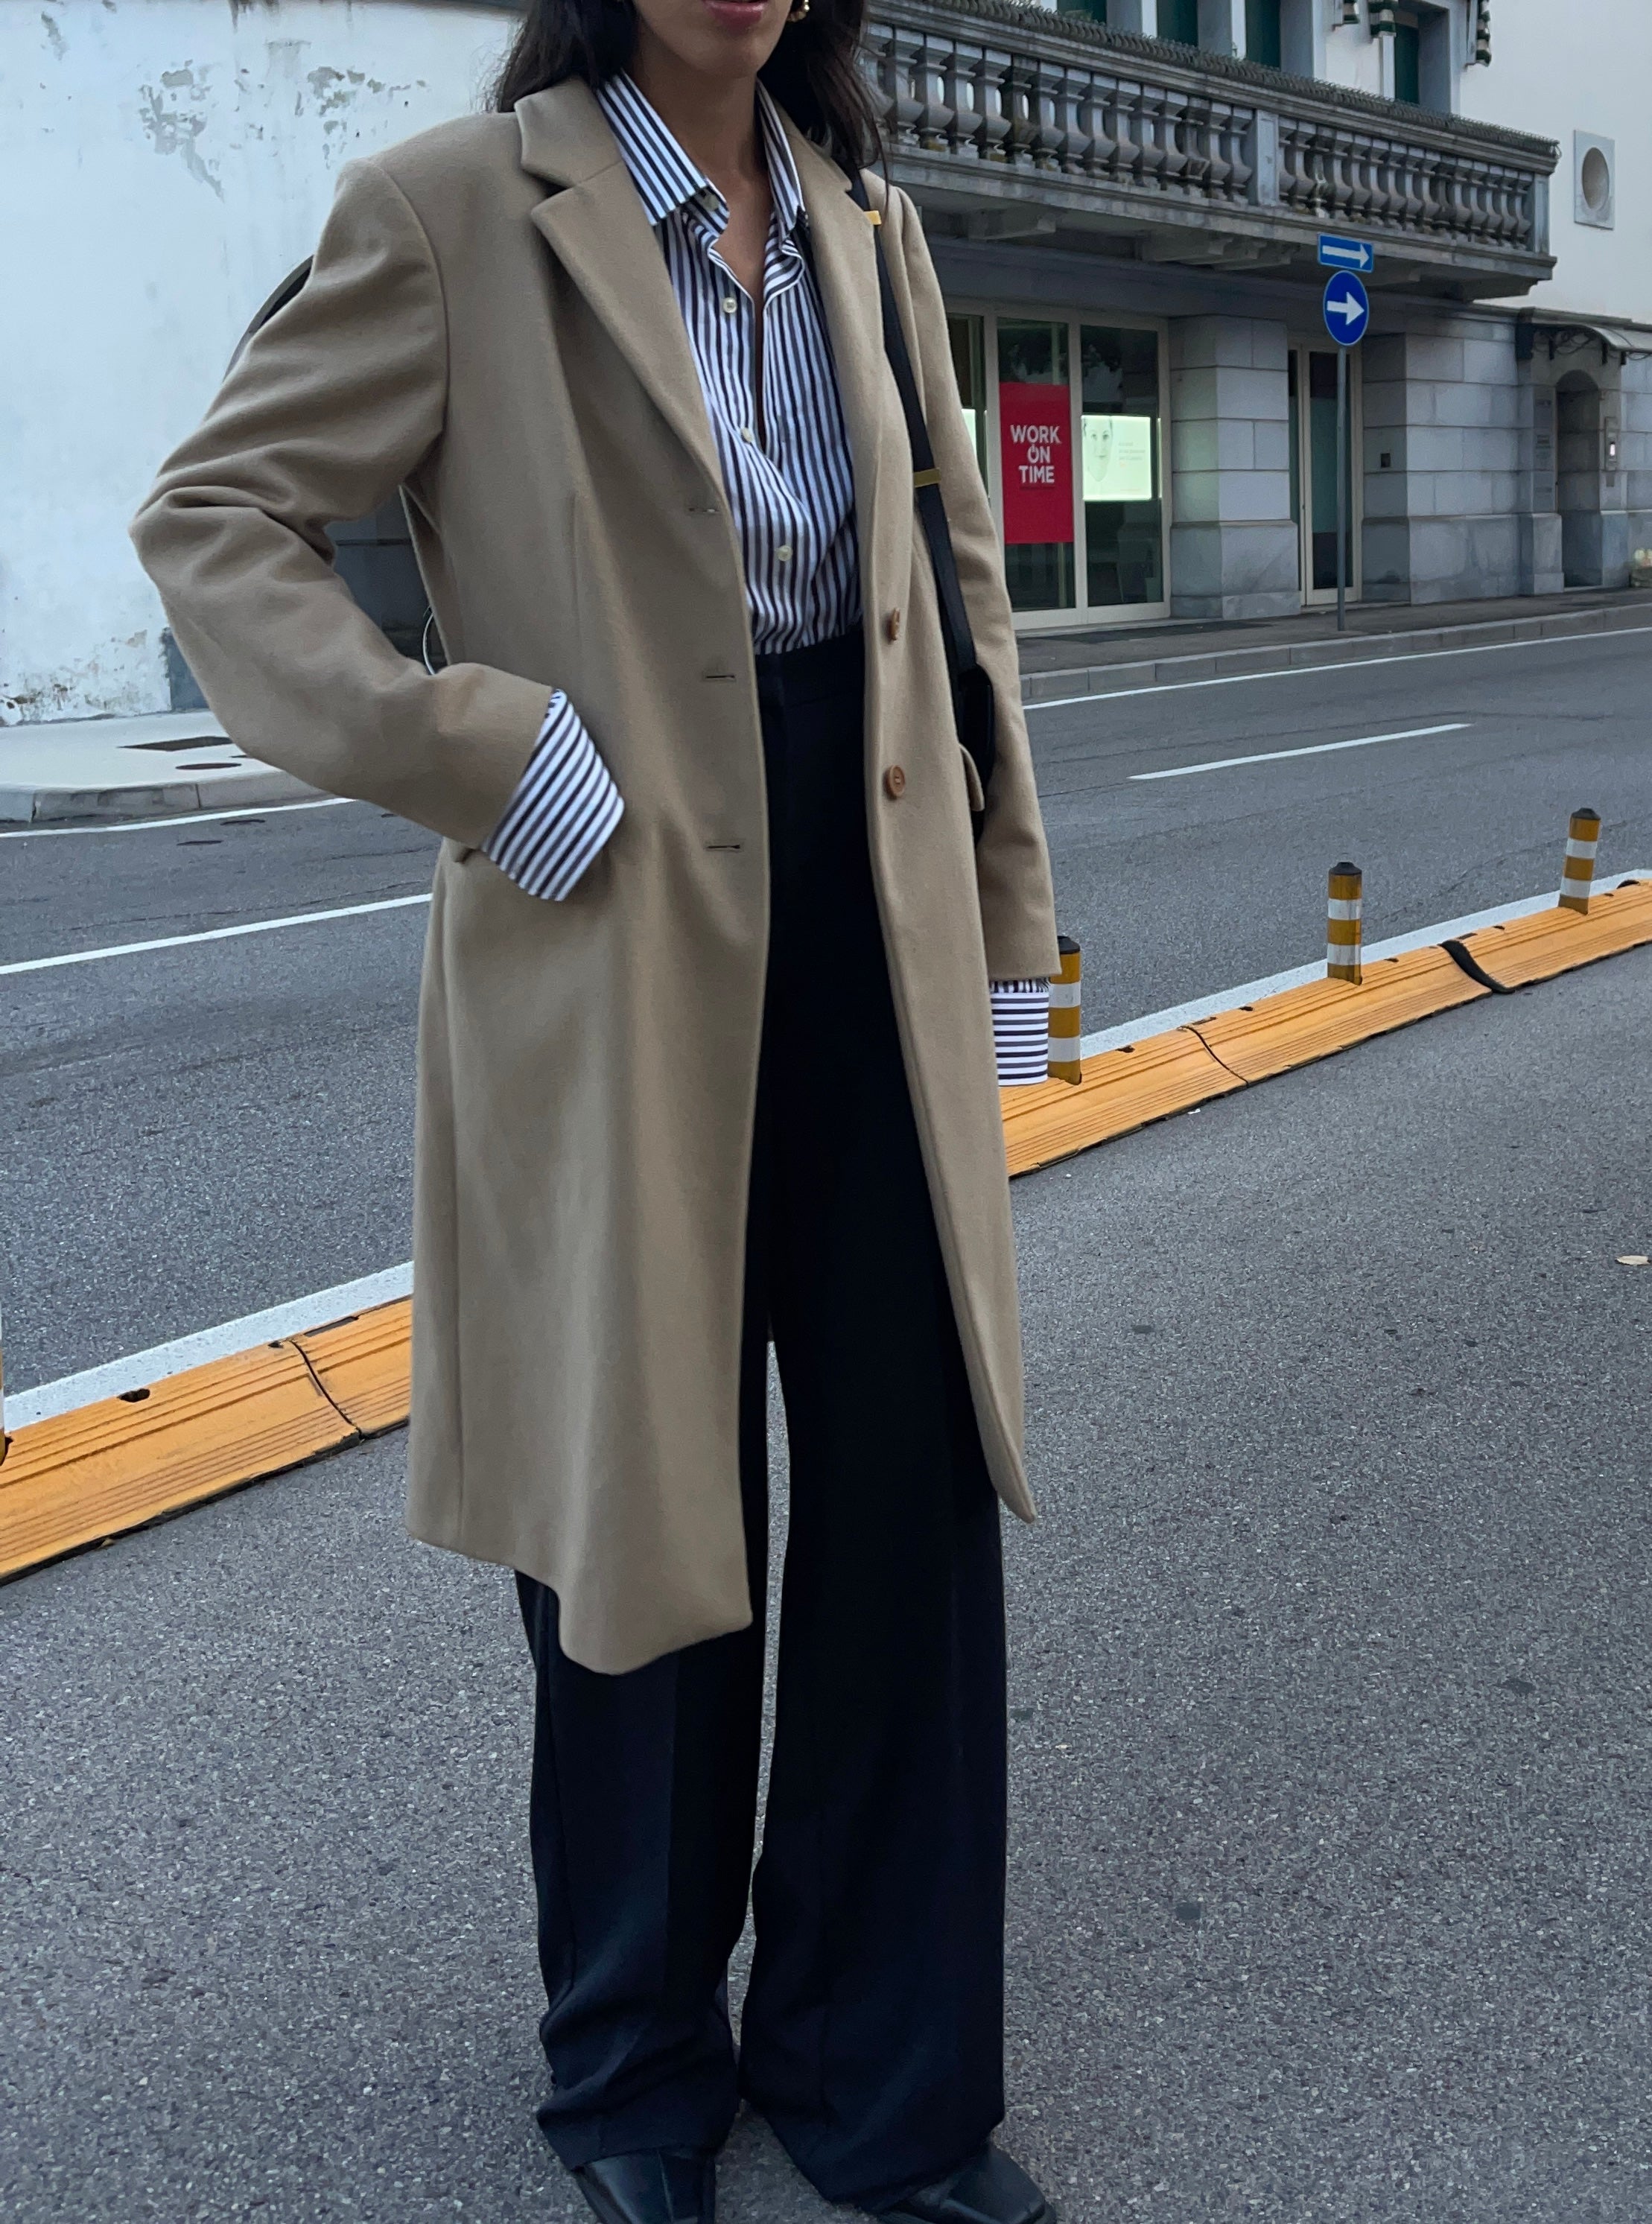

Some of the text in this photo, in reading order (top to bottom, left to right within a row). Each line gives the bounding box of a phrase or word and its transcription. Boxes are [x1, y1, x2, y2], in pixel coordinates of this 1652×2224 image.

[1010, 425, 1061, 444] WORK
[1027, 445, 1051, 463] ON
[1018, 466, 1055, 483] TIME
